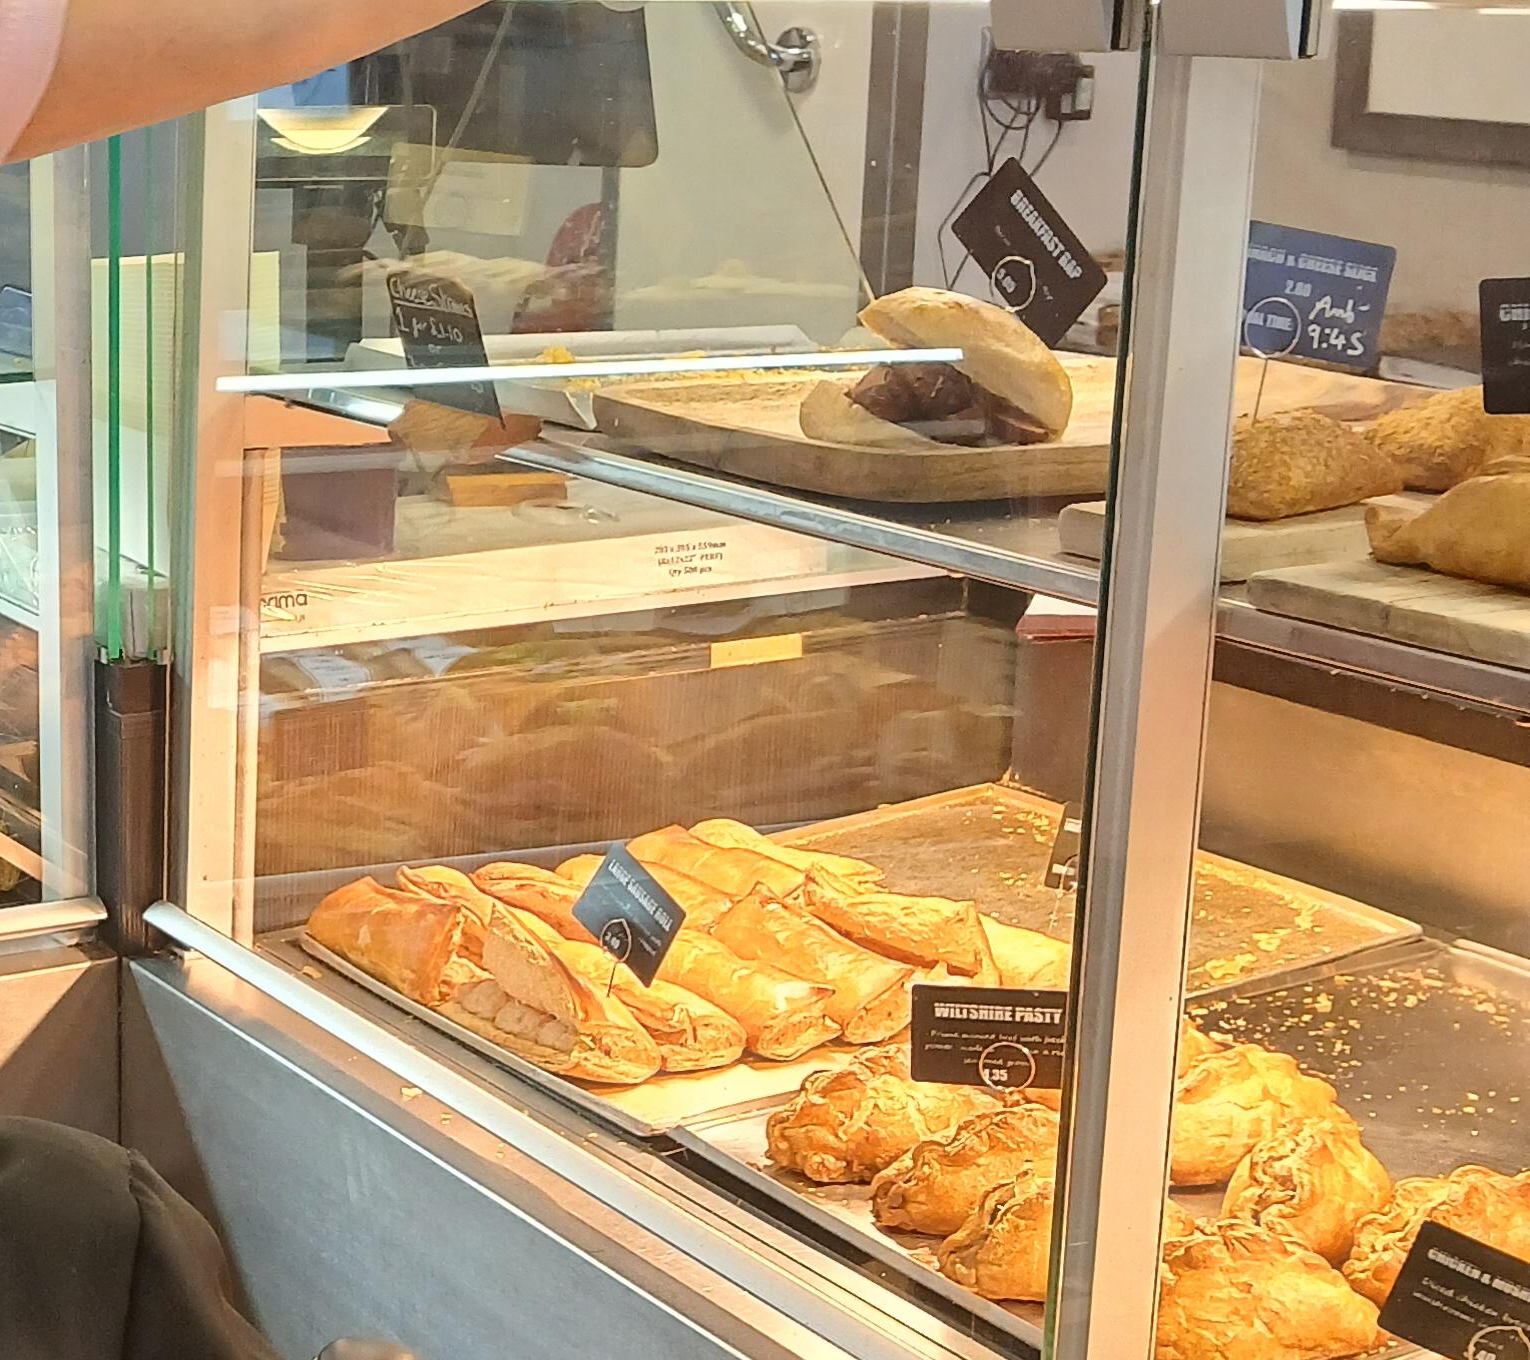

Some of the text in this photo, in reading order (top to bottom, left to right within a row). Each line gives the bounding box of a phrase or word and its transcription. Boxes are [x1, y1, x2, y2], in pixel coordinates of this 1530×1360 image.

[1010, 189, 1083, 279] BREAKFAST BAP
[1307, 324, 1365, 356] 9:45
[627, 878, 659, 916] SAUSAGE
[653, 907, 674, 933] ROLL
[933, 1002, 1064, 1025] WILTSHIRE PASTY
